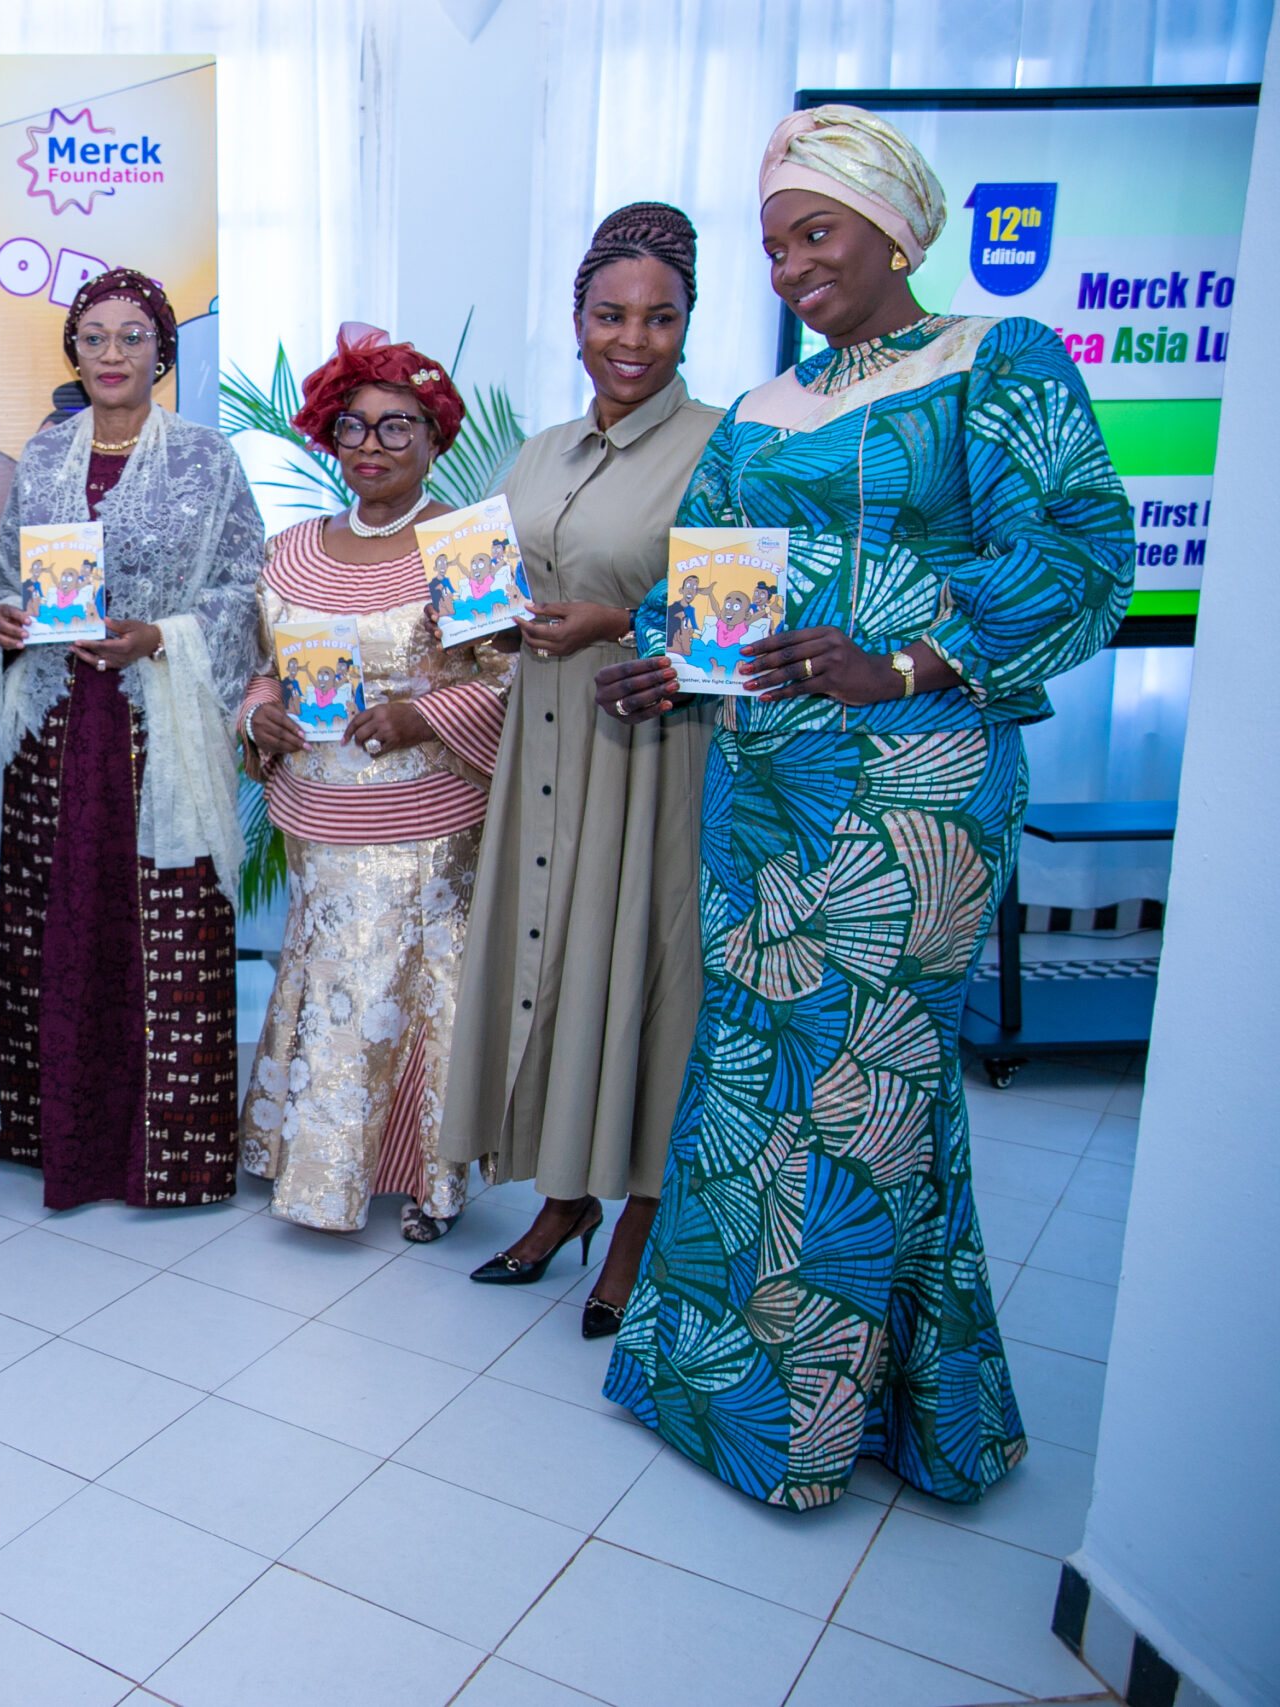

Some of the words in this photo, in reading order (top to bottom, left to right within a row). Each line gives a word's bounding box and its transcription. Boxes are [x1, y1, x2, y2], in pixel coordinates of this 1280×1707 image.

[48, 136, 162, 164] Merck
[48, 168, 164, 183] Foundation
[986, 206, 1042, 242] 12th
[982, 248, 1036, 265] Edition
[1077, 271, 1189, 309] Merck
[1111, 326, 1189, 363] Asia
[1141, 501, 1198, 527] First
[425, 535, 451, 556] RAY
[454, 528, 470, 540] OF
[675, 553, 710, 574] RAY
[713, 552, 735, 565] OF
[738, 554, 782, 576] HOPE
[281, 641, 303, 657] RAY
[305, 640, 320, 649] OF
